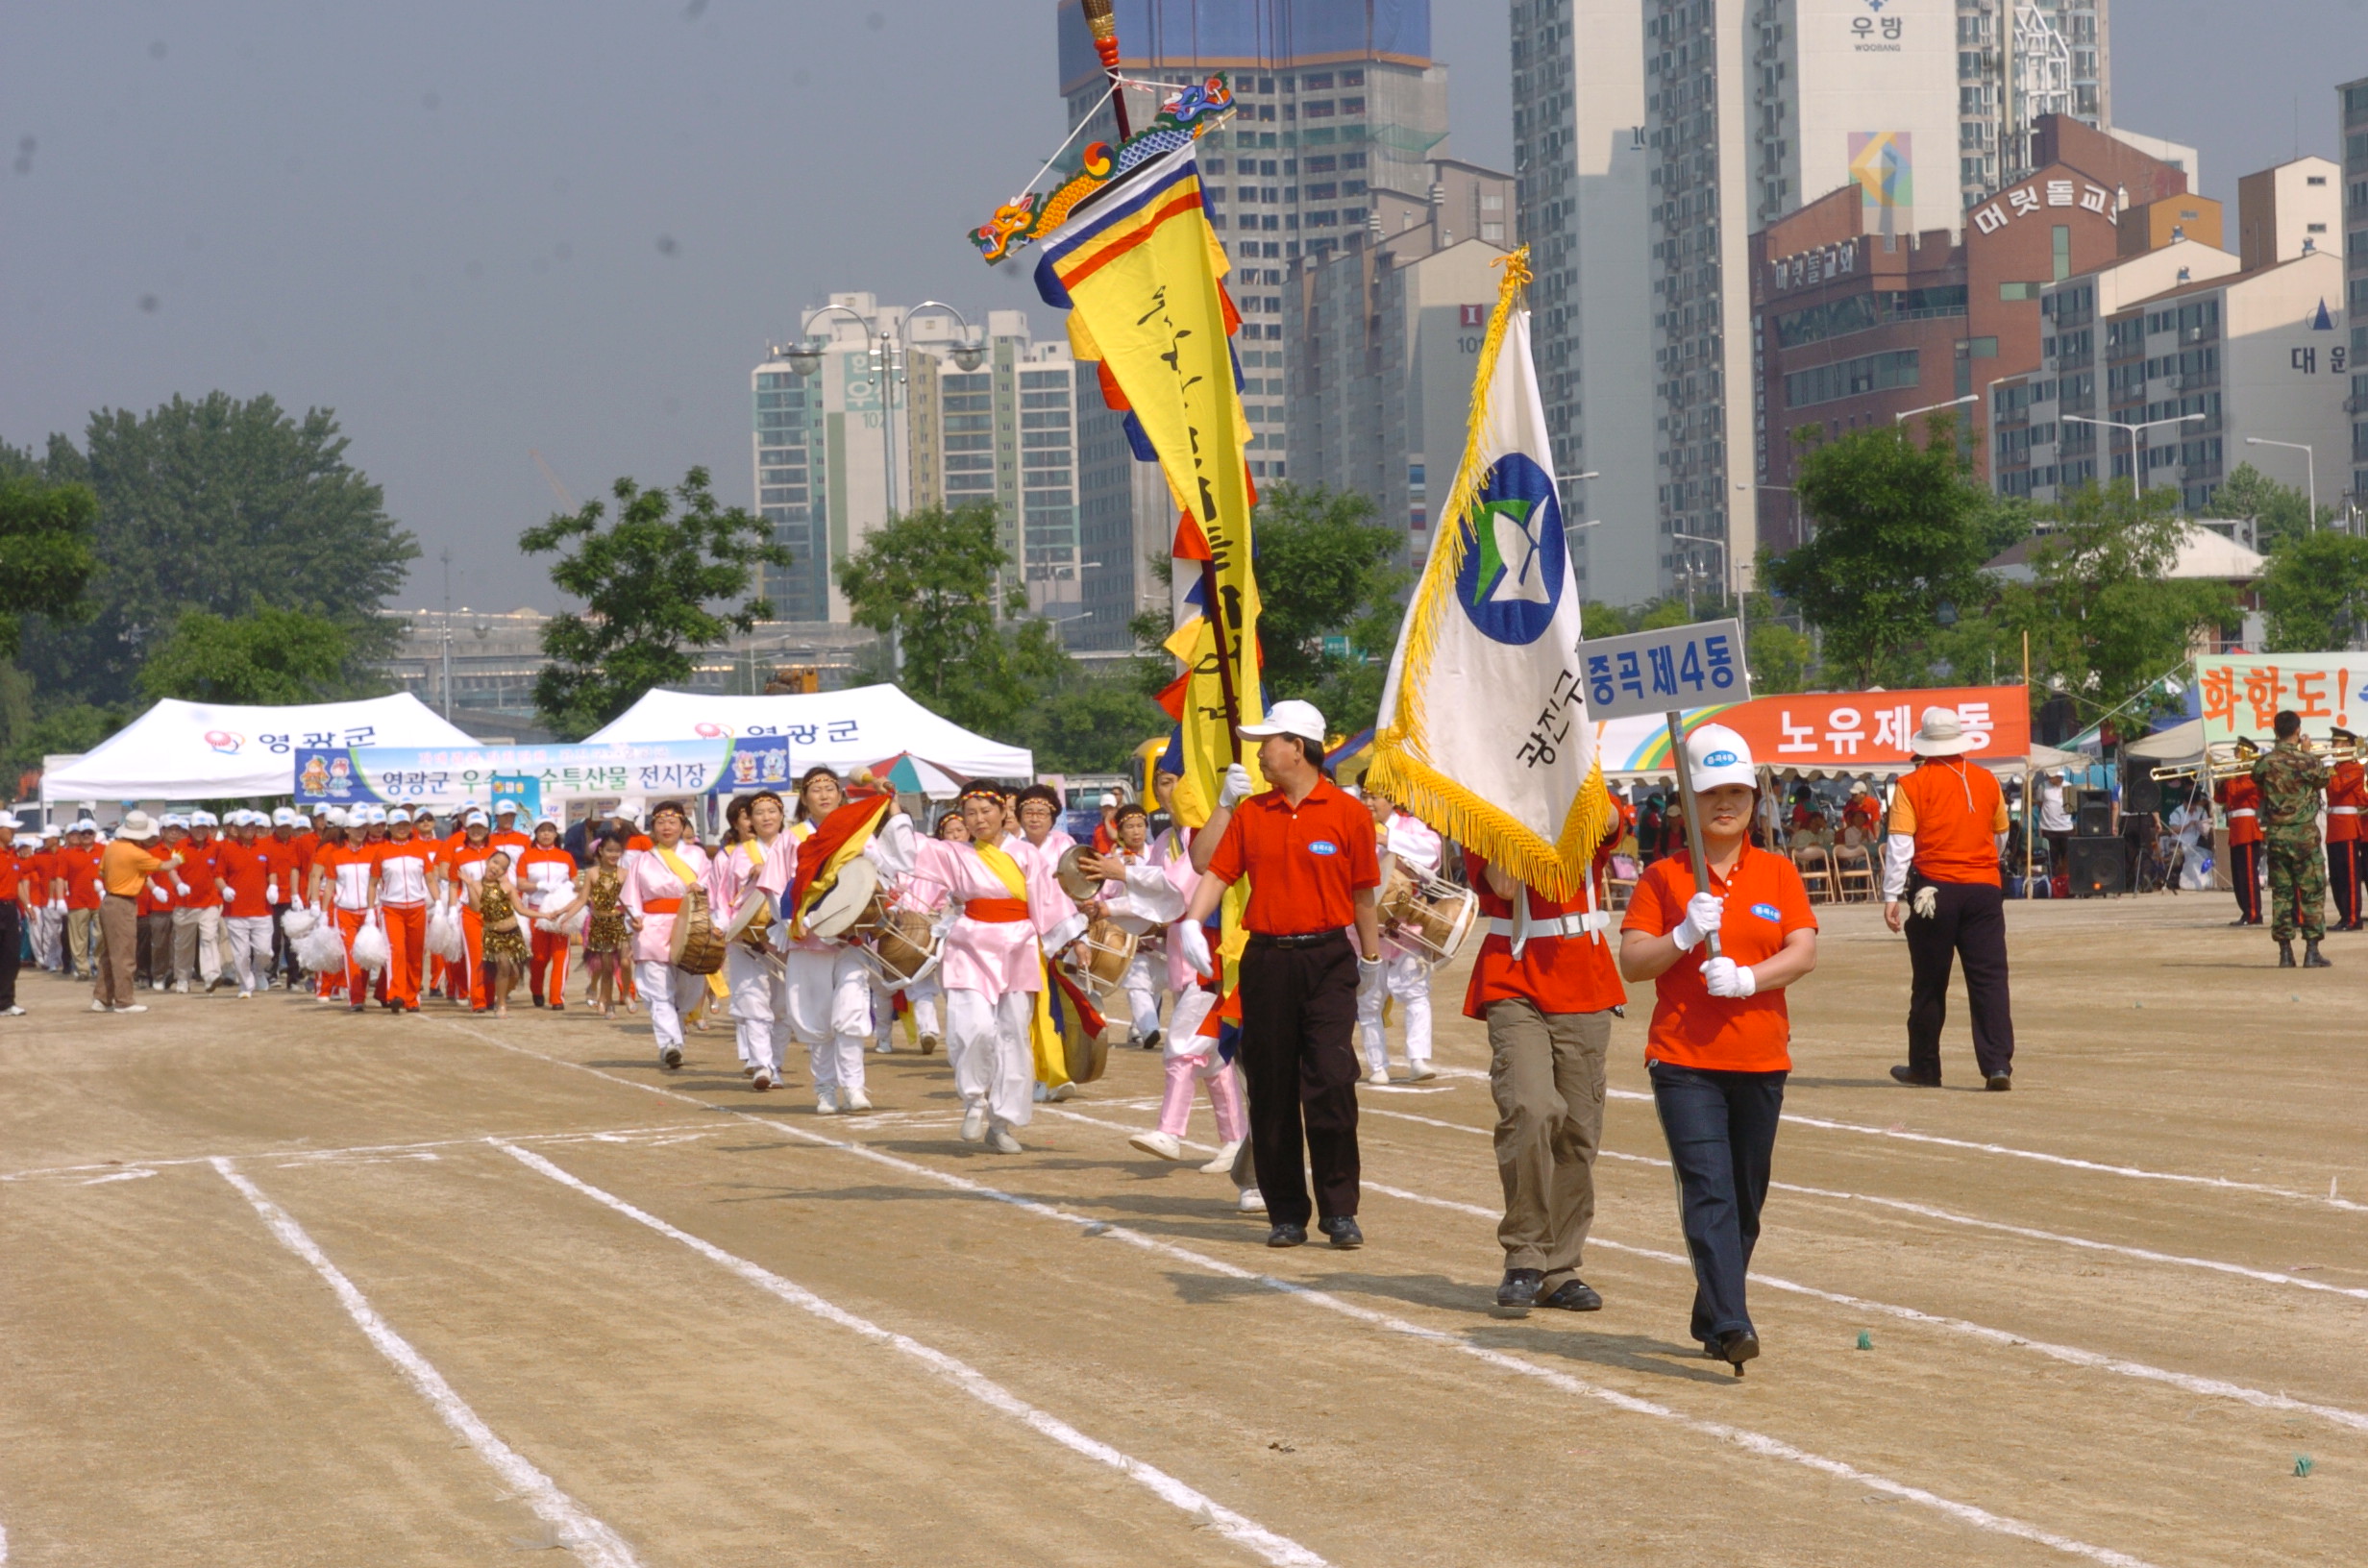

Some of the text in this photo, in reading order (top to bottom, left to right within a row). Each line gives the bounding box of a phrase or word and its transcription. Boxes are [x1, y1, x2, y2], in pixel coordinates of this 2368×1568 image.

[1850, 16, 1903, 40] 우방
[1974, 180, 2118, 235] 머릿돌교
[1775, 244, 1854, 290] 머릿돌교회
[1587, 634, 1735, 706] 중곡제4동
[1516, 669, 1583, 769] 광진구
[2200, 666, 2349, 733] 화합도!
[259, 725, 376, 754] 영광군
[1777, 701, 1994, 755] 노유제동
[382, 771, 450, 796] 영광군
[639, 763, 706, 790] 전시장
